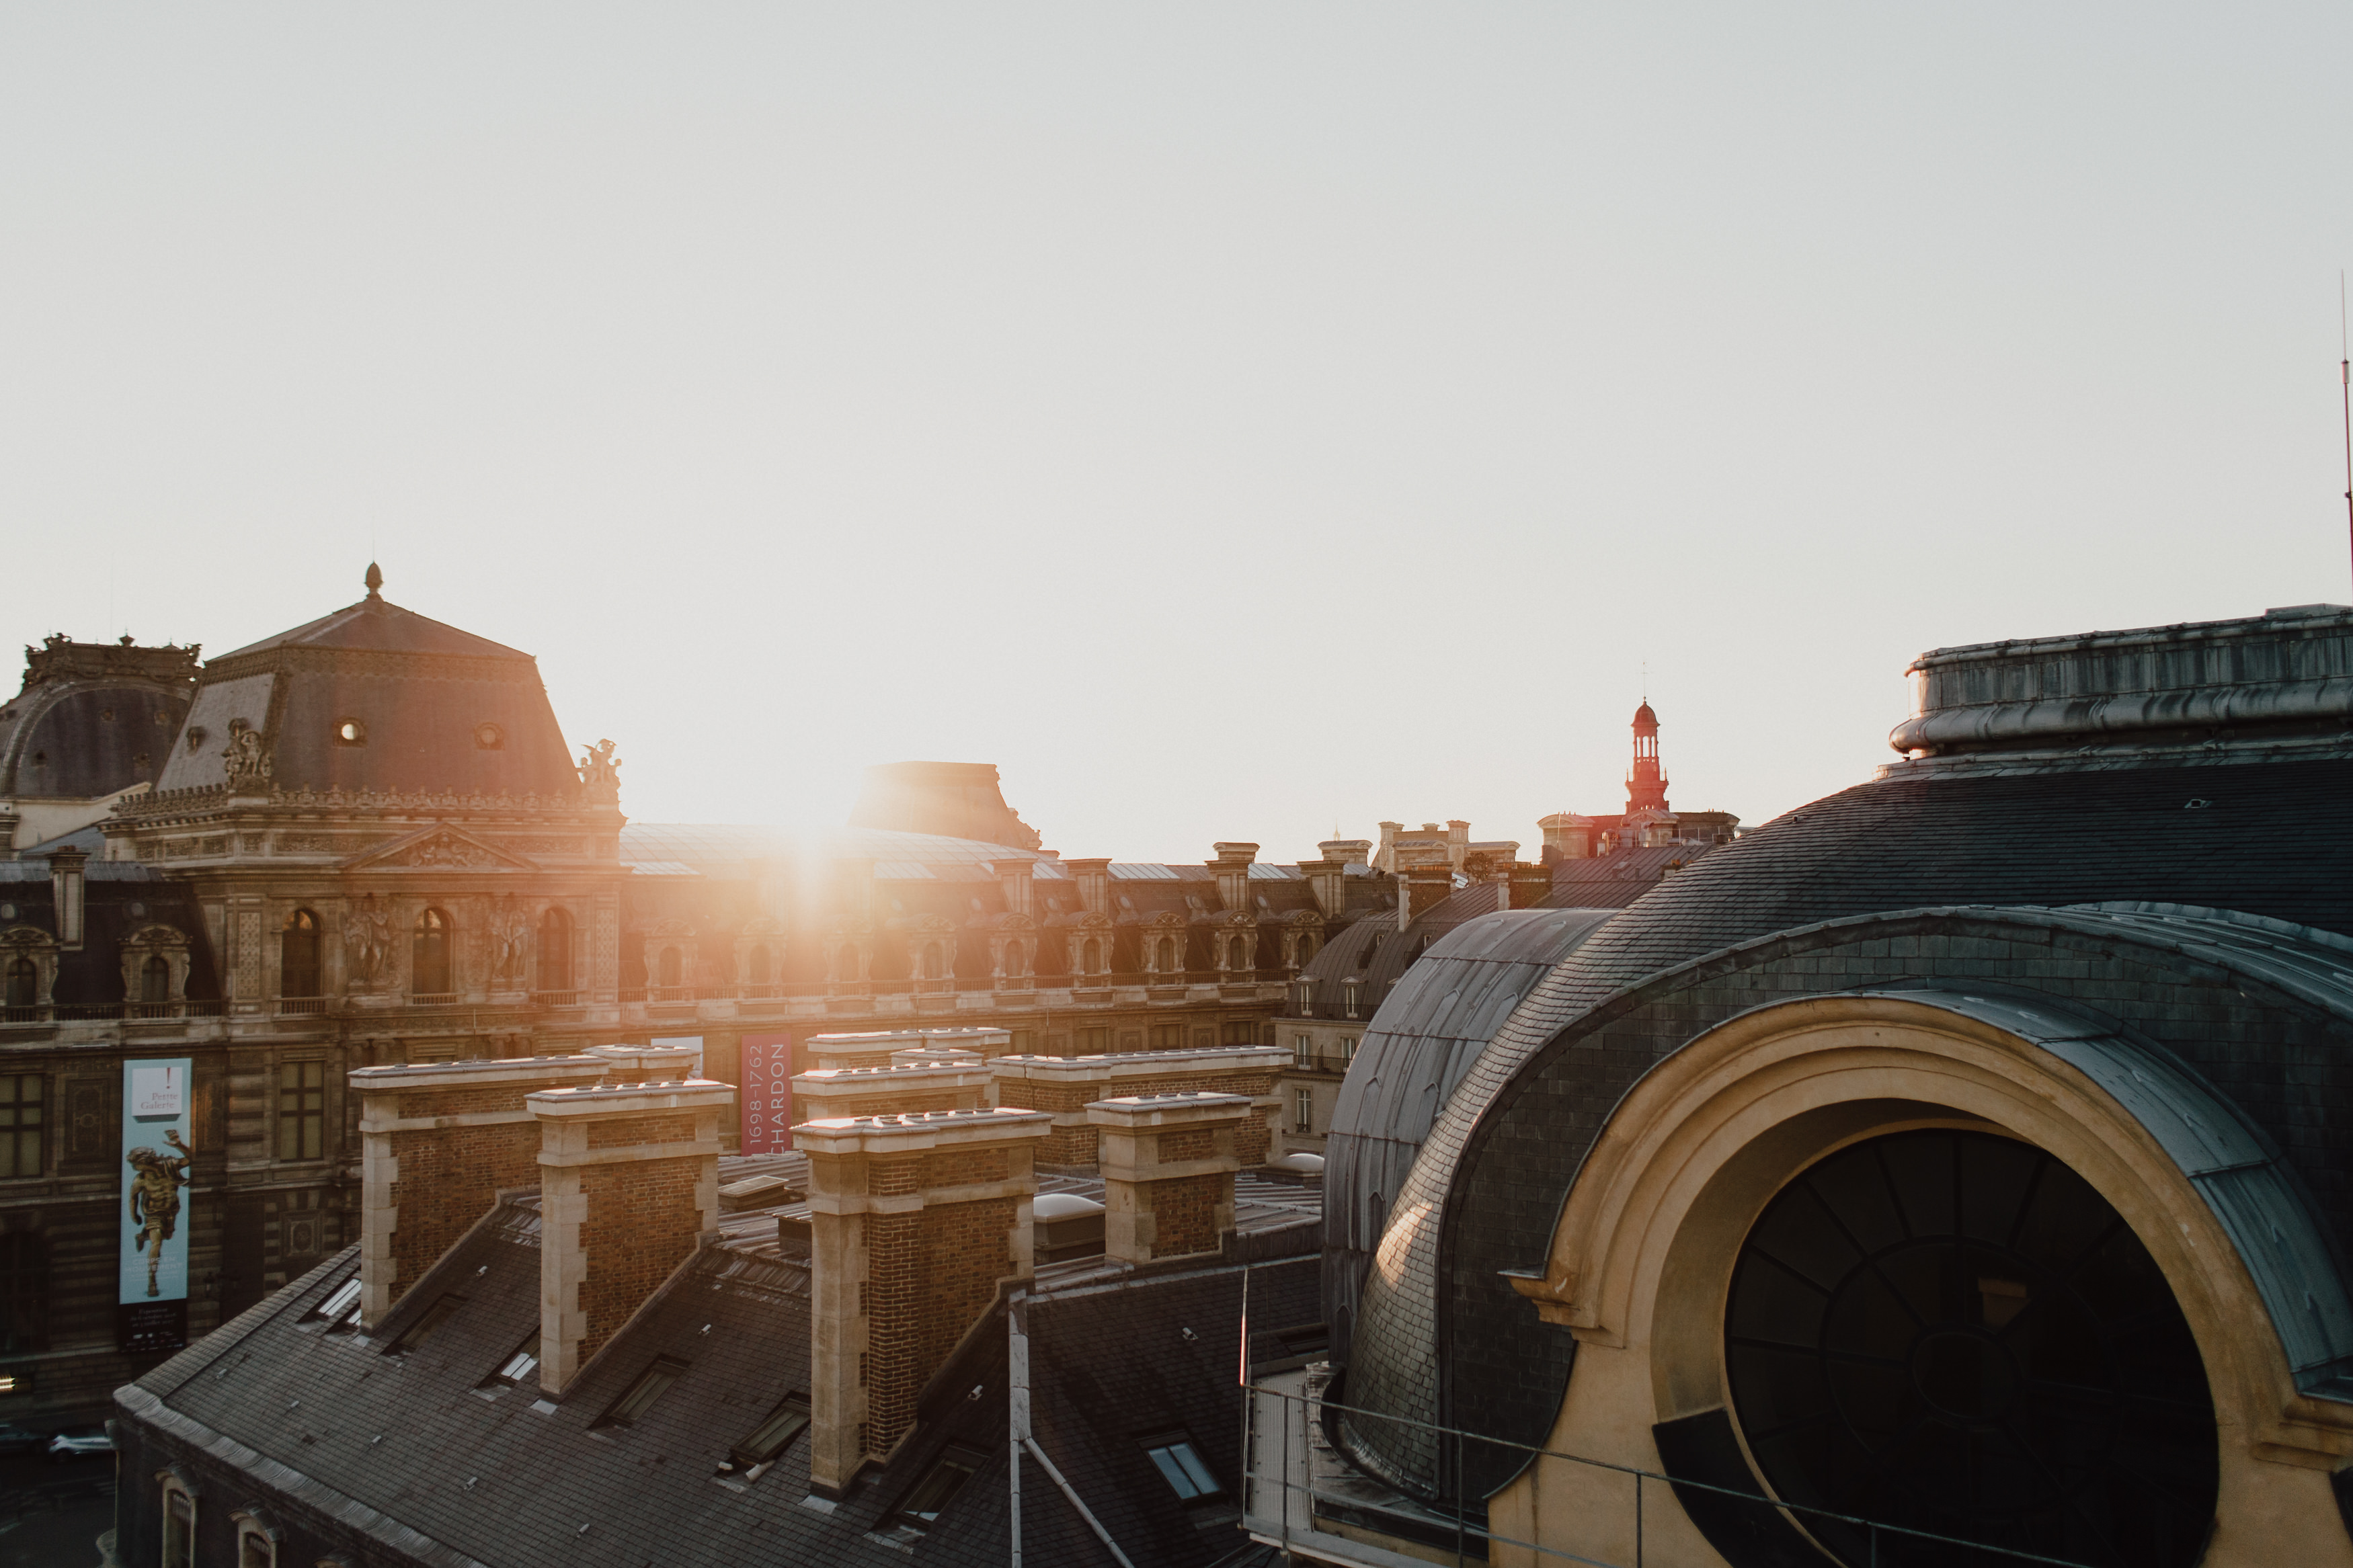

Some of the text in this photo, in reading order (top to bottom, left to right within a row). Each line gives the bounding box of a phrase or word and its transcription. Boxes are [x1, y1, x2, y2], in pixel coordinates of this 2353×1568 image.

[749, 1044, 763, 1145] 1698-1762
[141, 1101, 174, 1110] Galerie
[132, 1257, 161, 1265] CORPS
[124, 1262, 183, 1272] MOUVEMENT
